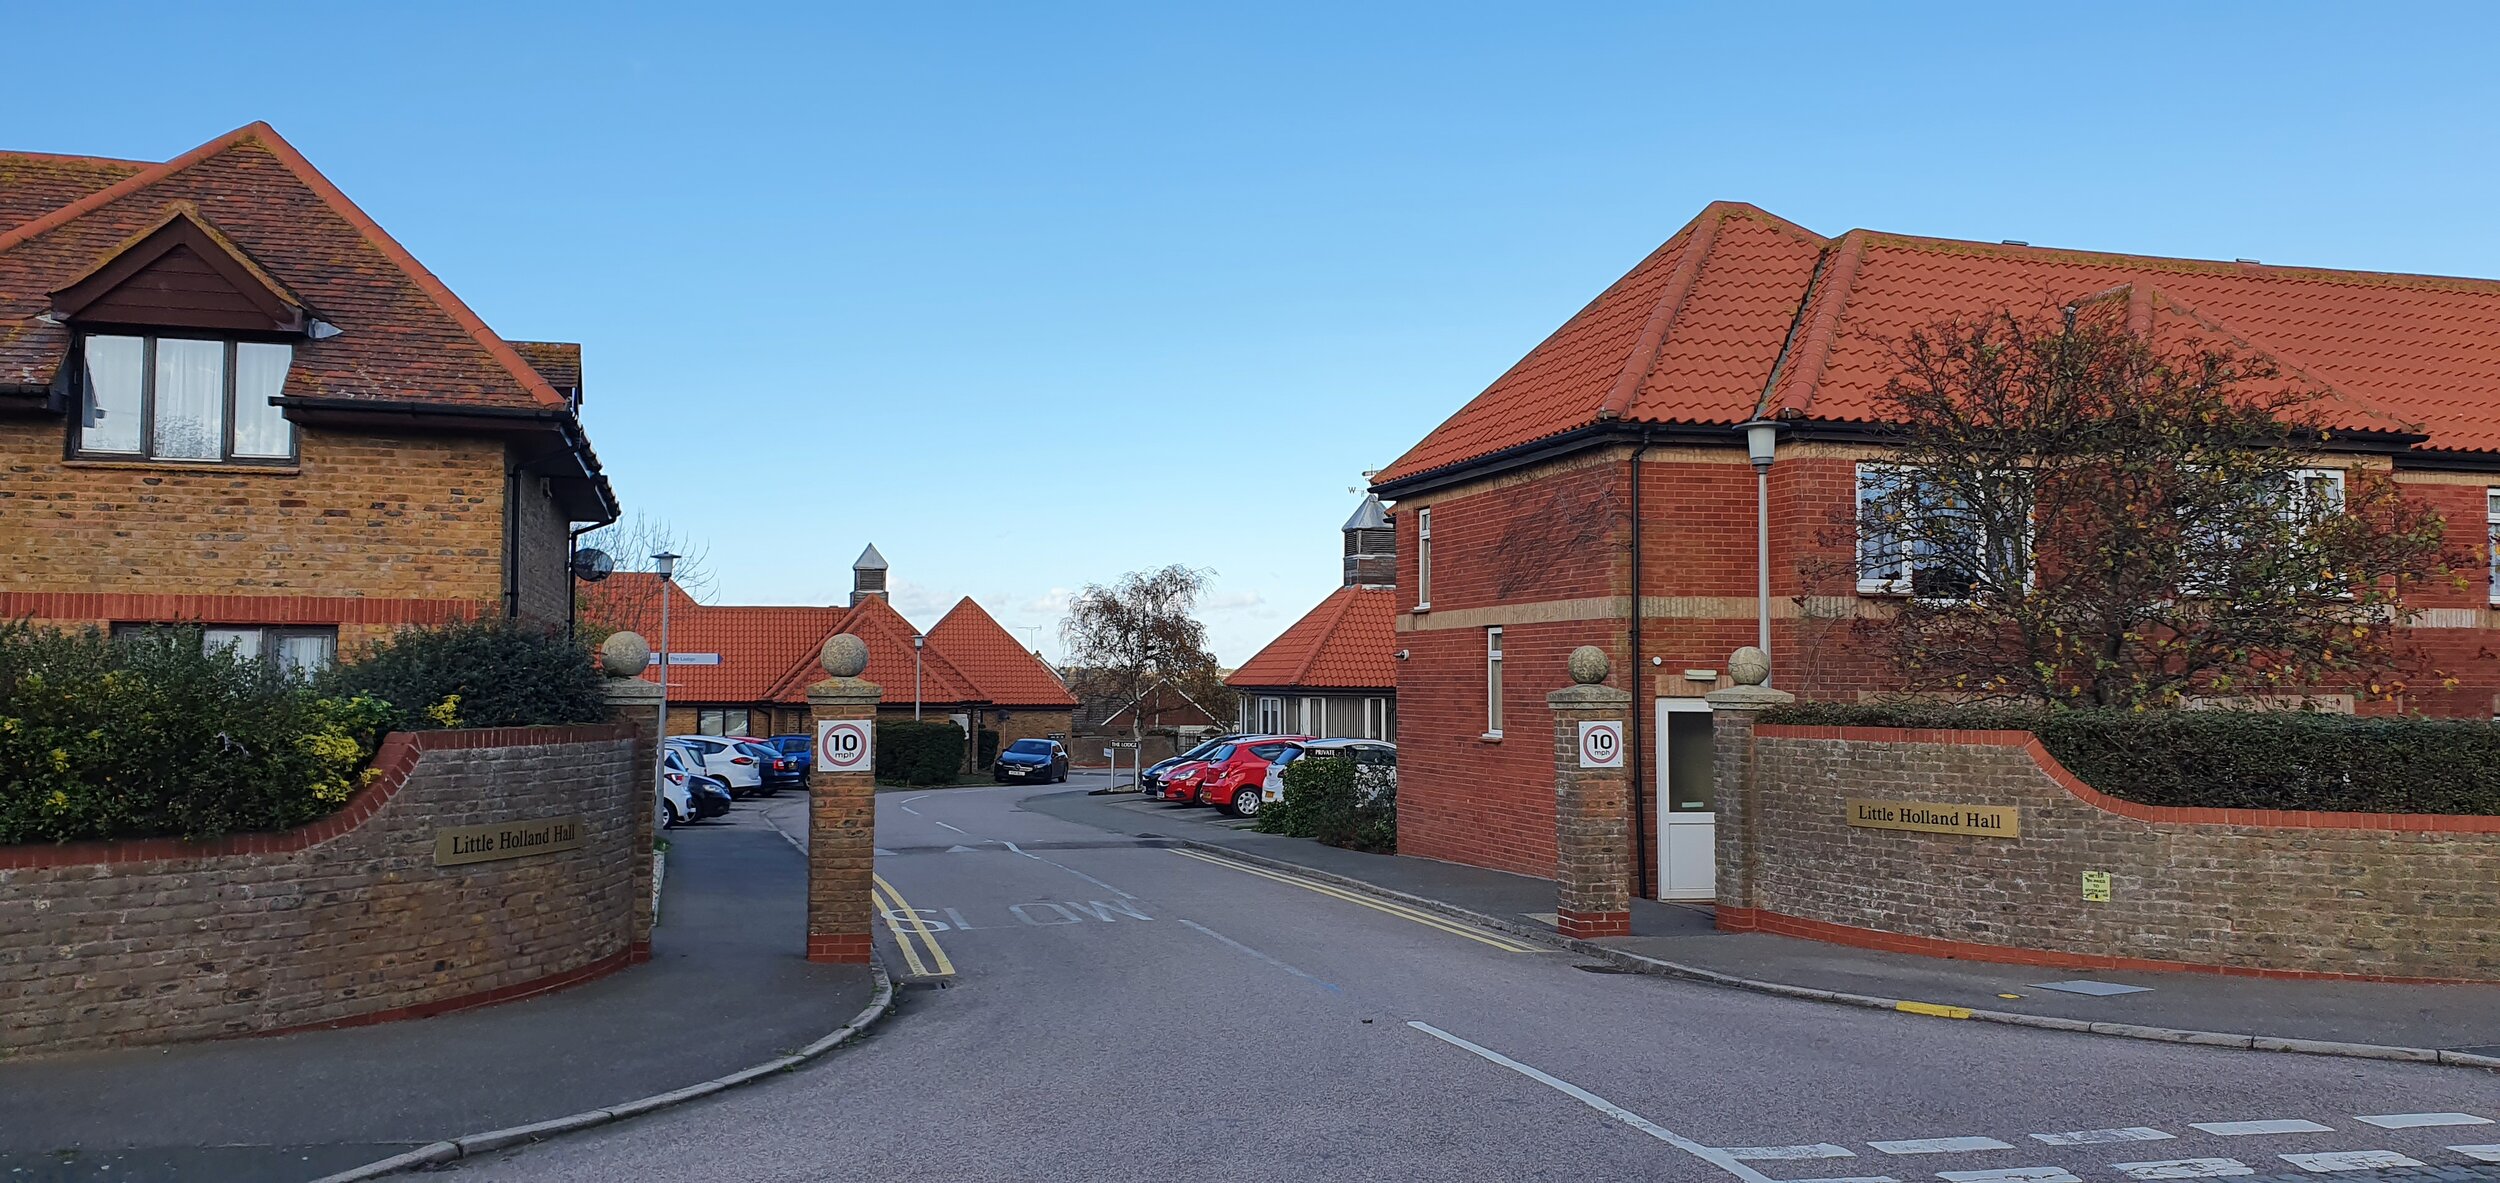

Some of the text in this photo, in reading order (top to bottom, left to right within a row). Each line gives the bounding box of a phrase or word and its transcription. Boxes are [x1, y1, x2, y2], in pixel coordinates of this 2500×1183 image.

[831, 734, 857, 751] 10
[1591, 734, 1612, 749] 10
[1858, 805, 2001, 829] Little Holland Hall
[452, 824, 575, 855] Little Holland Hall
[880, 899, 1154, 933] SLOW
